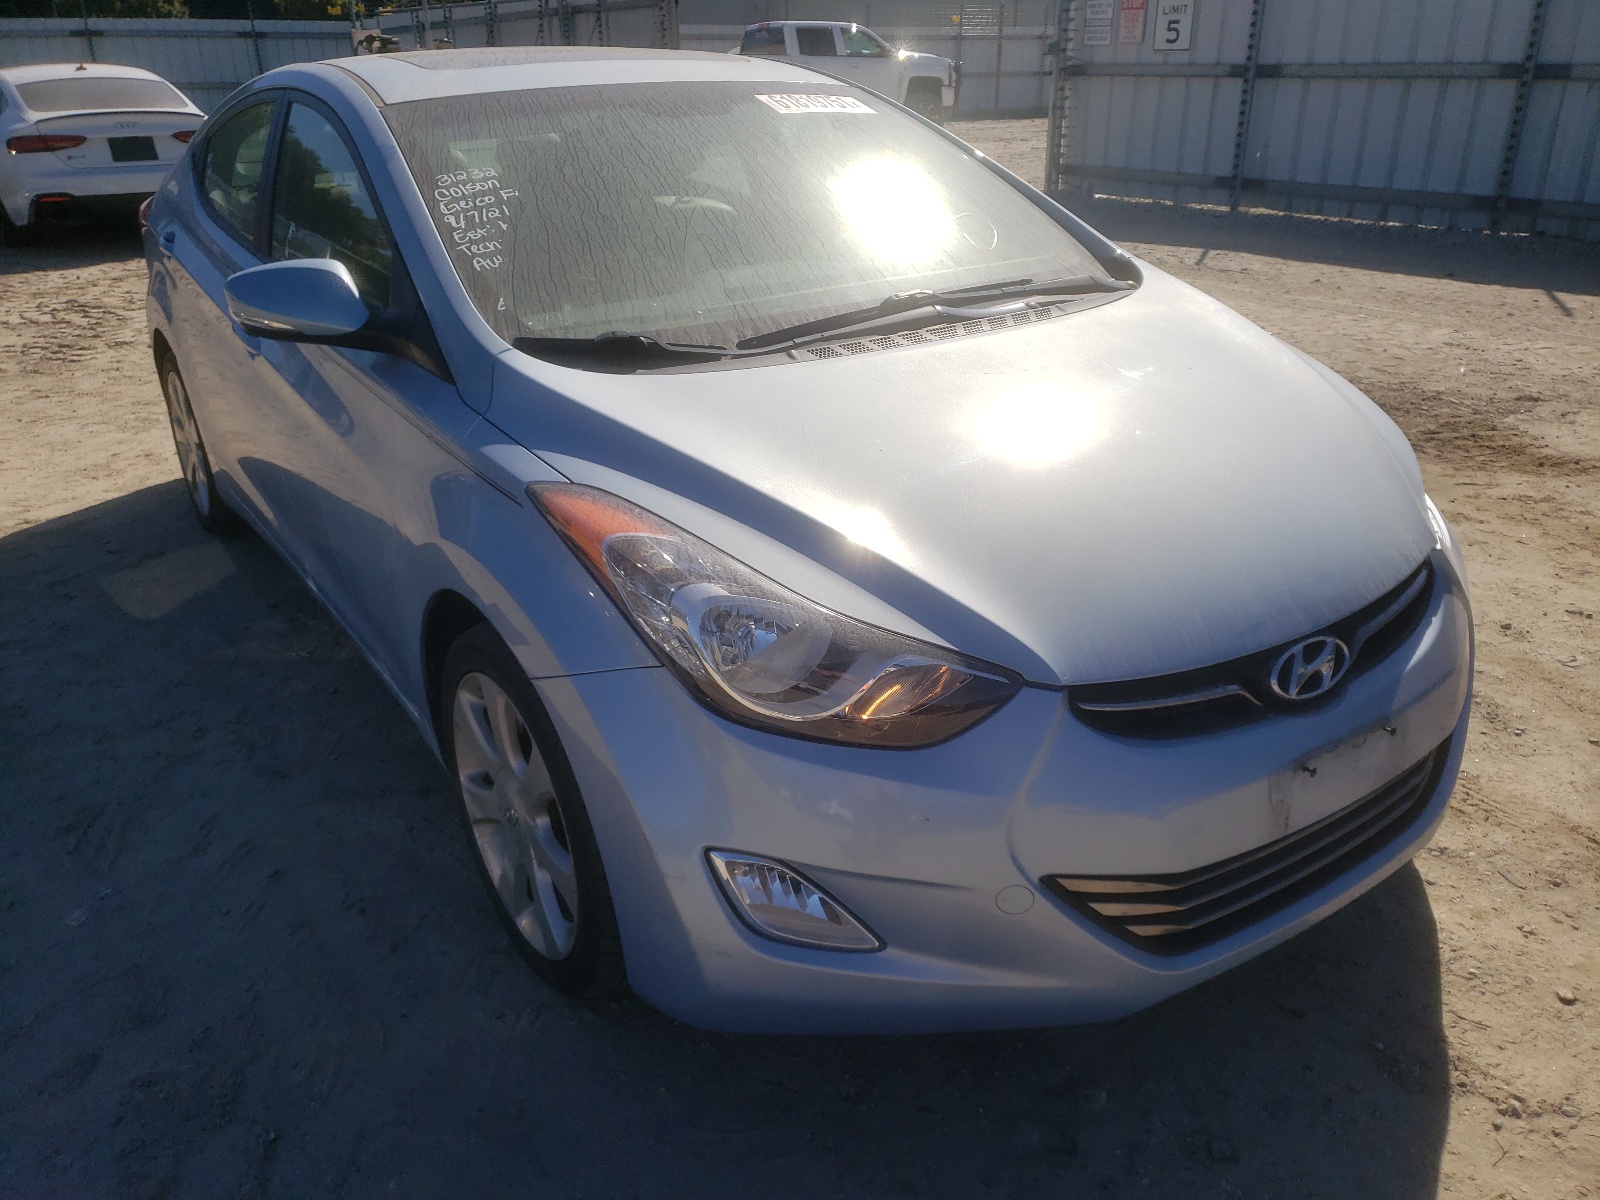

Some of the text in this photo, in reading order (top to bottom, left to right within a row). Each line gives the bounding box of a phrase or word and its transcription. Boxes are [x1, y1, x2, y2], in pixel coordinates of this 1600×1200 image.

[1162, 4, 1189, 15] LIMIT
[1165, 19, 1181, 44] 5
[436, 167, 499, 186] 31232
[434, 179, 500, 201] Colson
[439, 195, 495, 214] Geico
